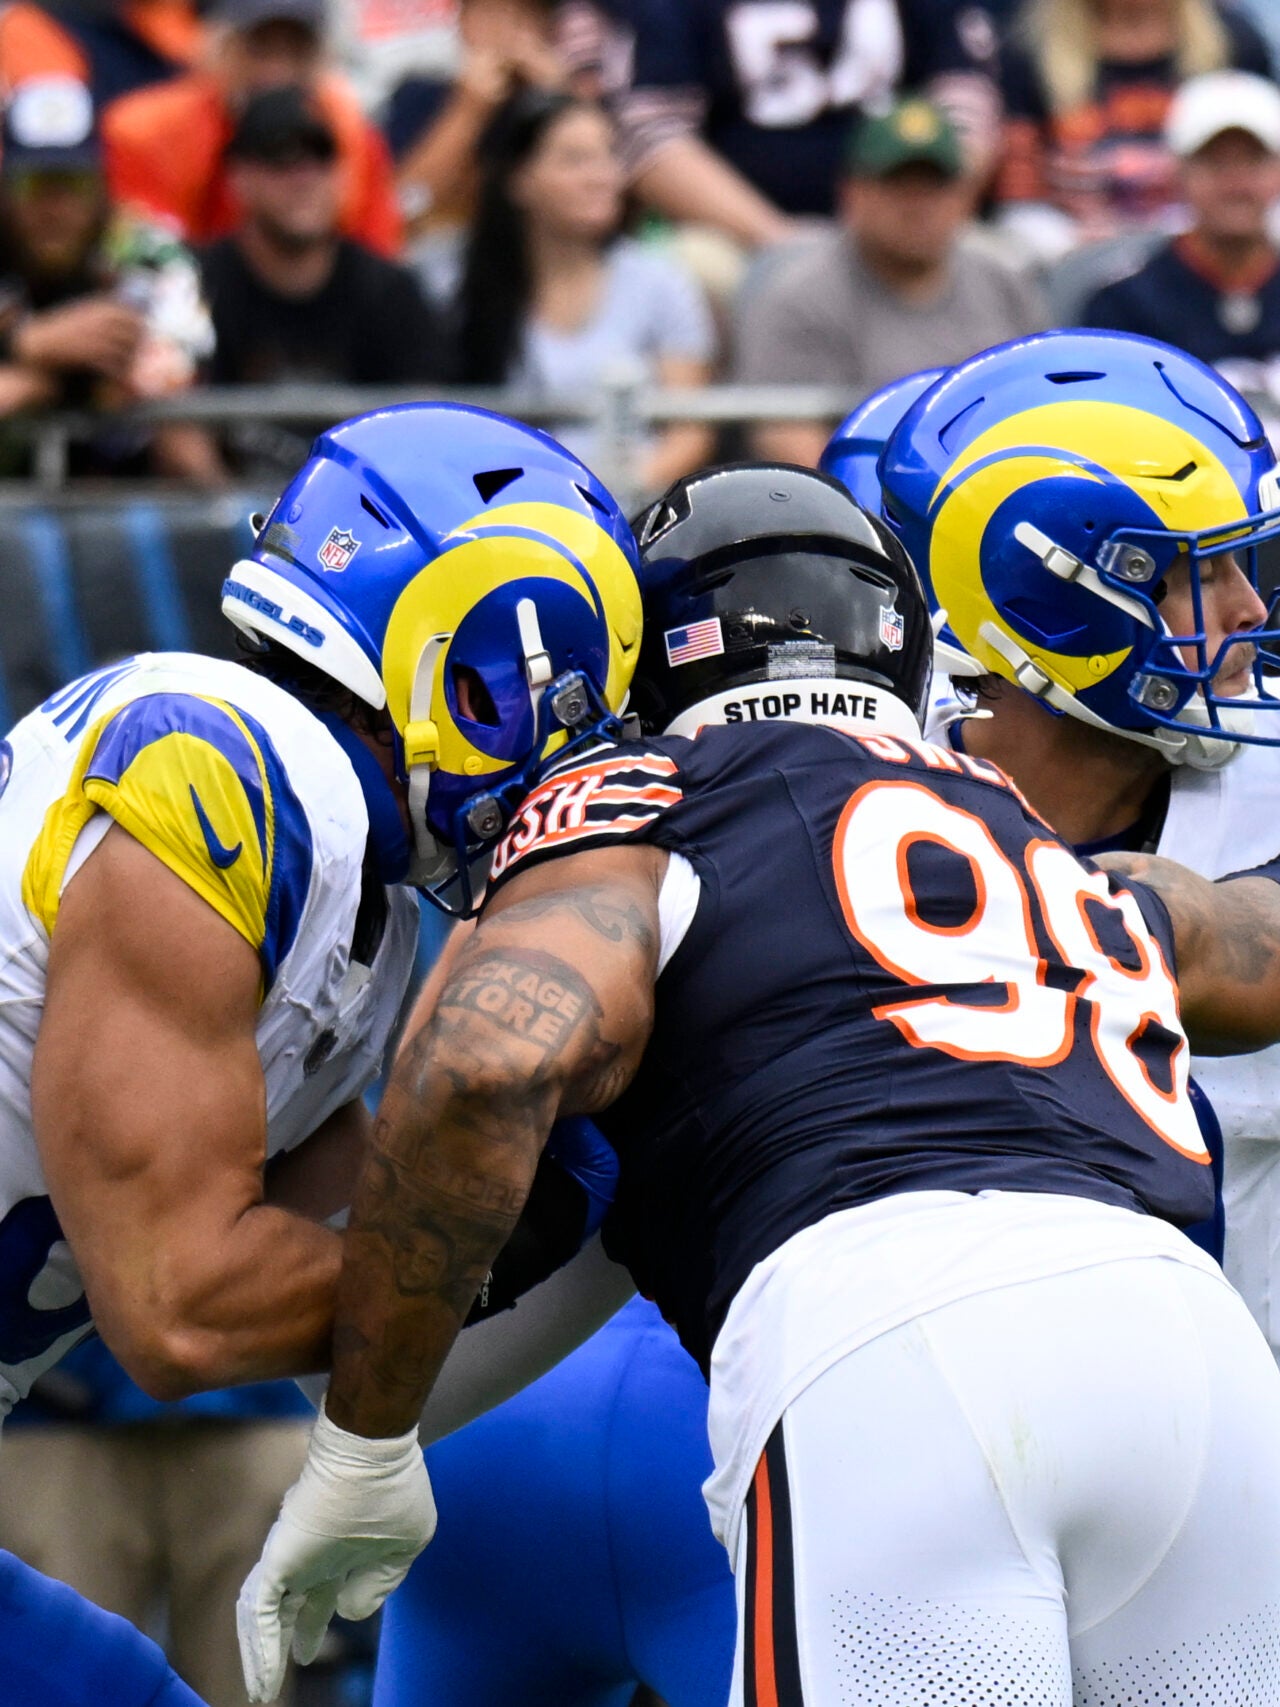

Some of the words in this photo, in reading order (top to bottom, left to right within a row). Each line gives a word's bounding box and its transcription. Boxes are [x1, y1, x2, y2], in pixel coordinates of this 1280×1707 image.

[321, 542, 346, 568] NFL
[882, 624, 901, 646] NFL
[724, 693, 801, 723] STOP
[811, 693, 877, 720] HATE
[832, 779, 1213, 1166] 98
